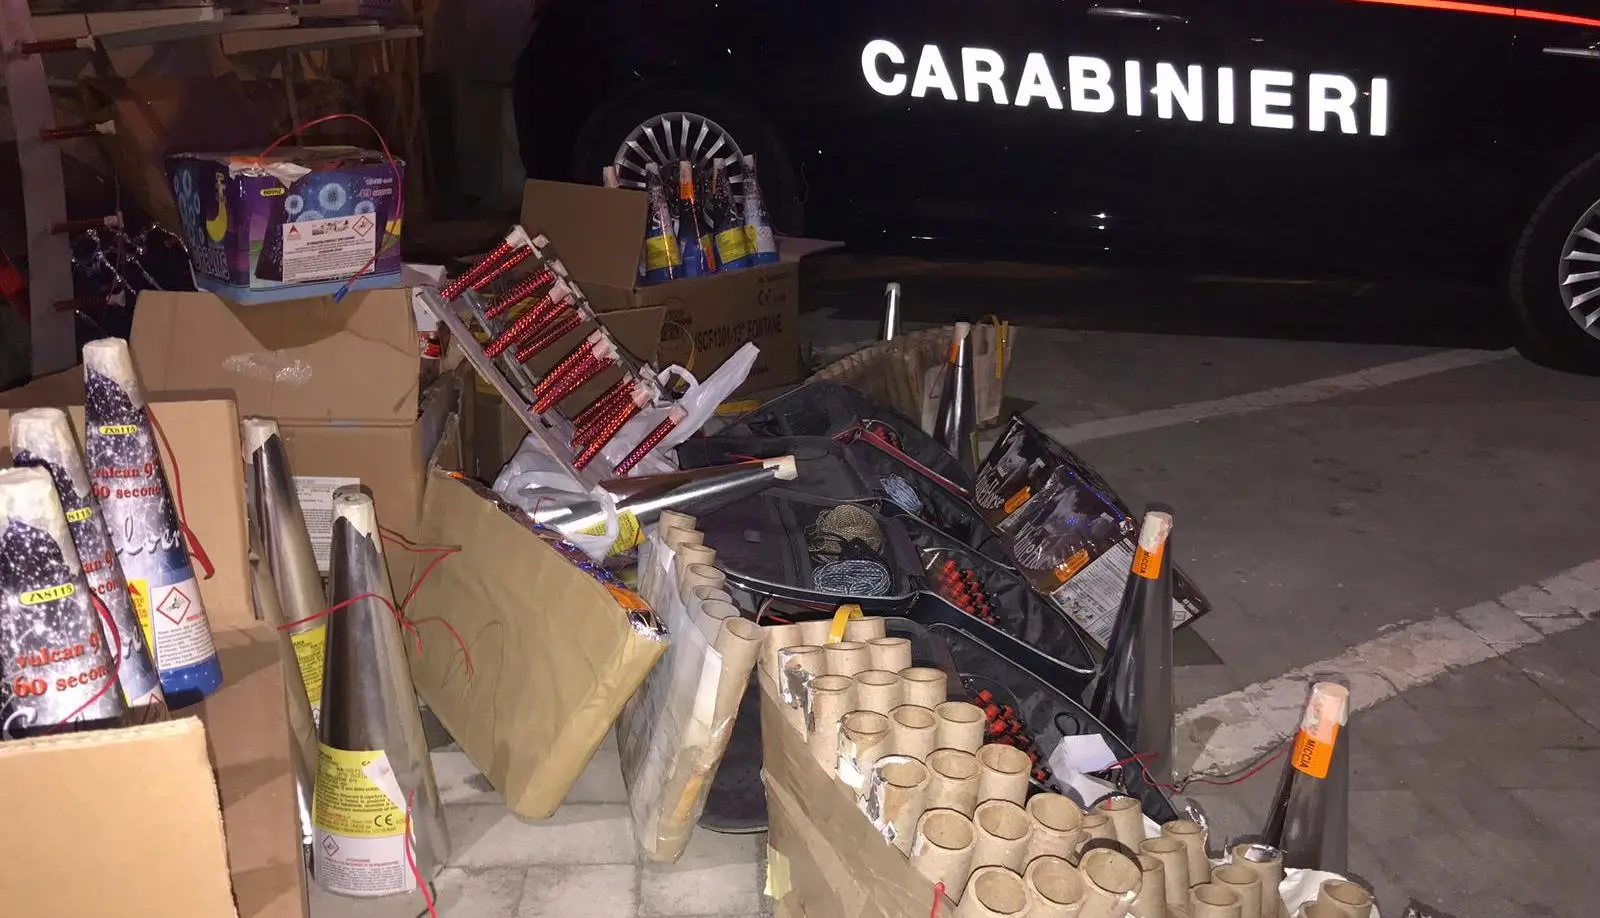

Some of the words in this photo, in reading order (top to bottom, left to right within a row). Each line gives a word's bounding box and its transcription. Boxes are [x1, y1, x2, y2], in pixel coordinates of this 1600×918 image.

[861, 39, 1389, 137] CARABINIERI
[68, 508, 91, 520] 8115
[1140, 549, 1150, 574] MICCIA
[29, 585, 74, 602] ZX8115
[16, 643, 86, 669] vulcan
[13, 675, 48, 698] 60
[55, 665, 109, 692] secon
[1299, 739, 1316, 768] MICCIA
